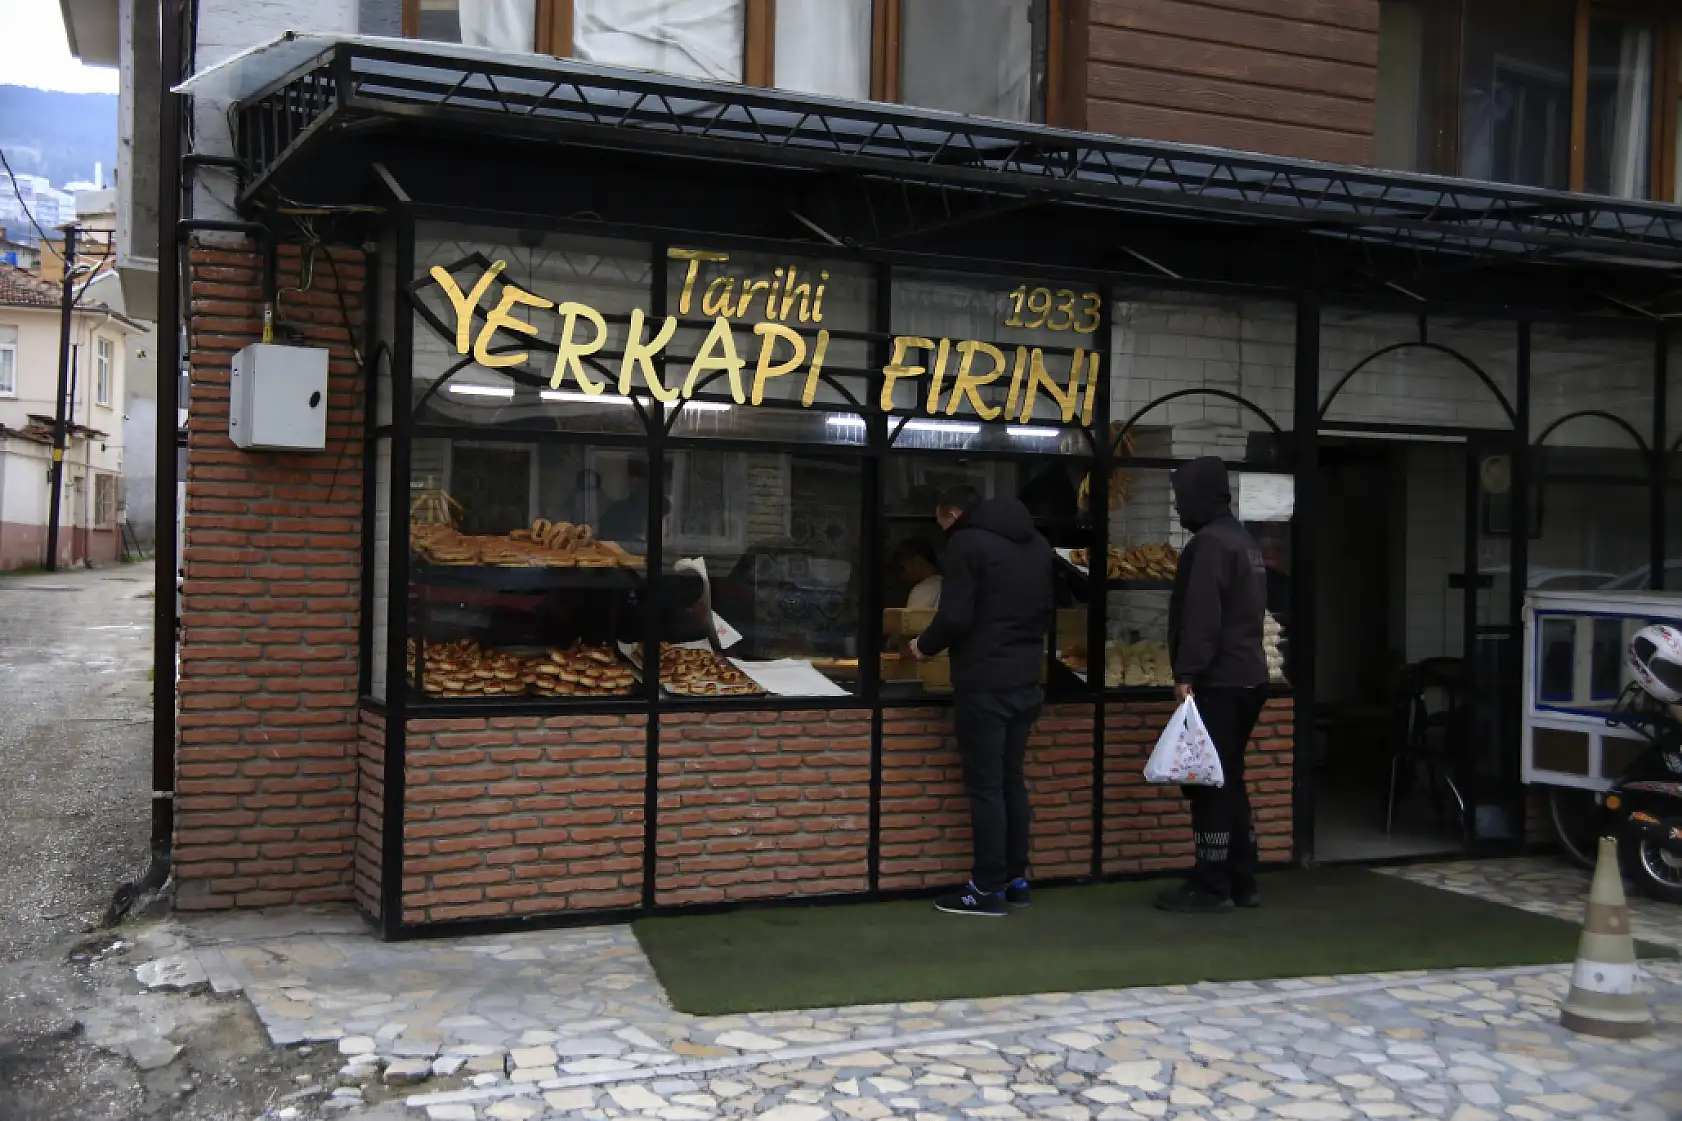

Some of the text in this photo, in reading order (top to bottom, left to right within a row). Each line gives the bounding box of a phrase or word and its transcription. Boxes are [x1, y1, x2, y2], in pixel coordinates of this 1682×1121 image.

[666, 247, 830, 324] Tarihi
[1004, 283, 1103, 335] 1933
[429, 258, 1101, 426] YERKAPI FIRINI
